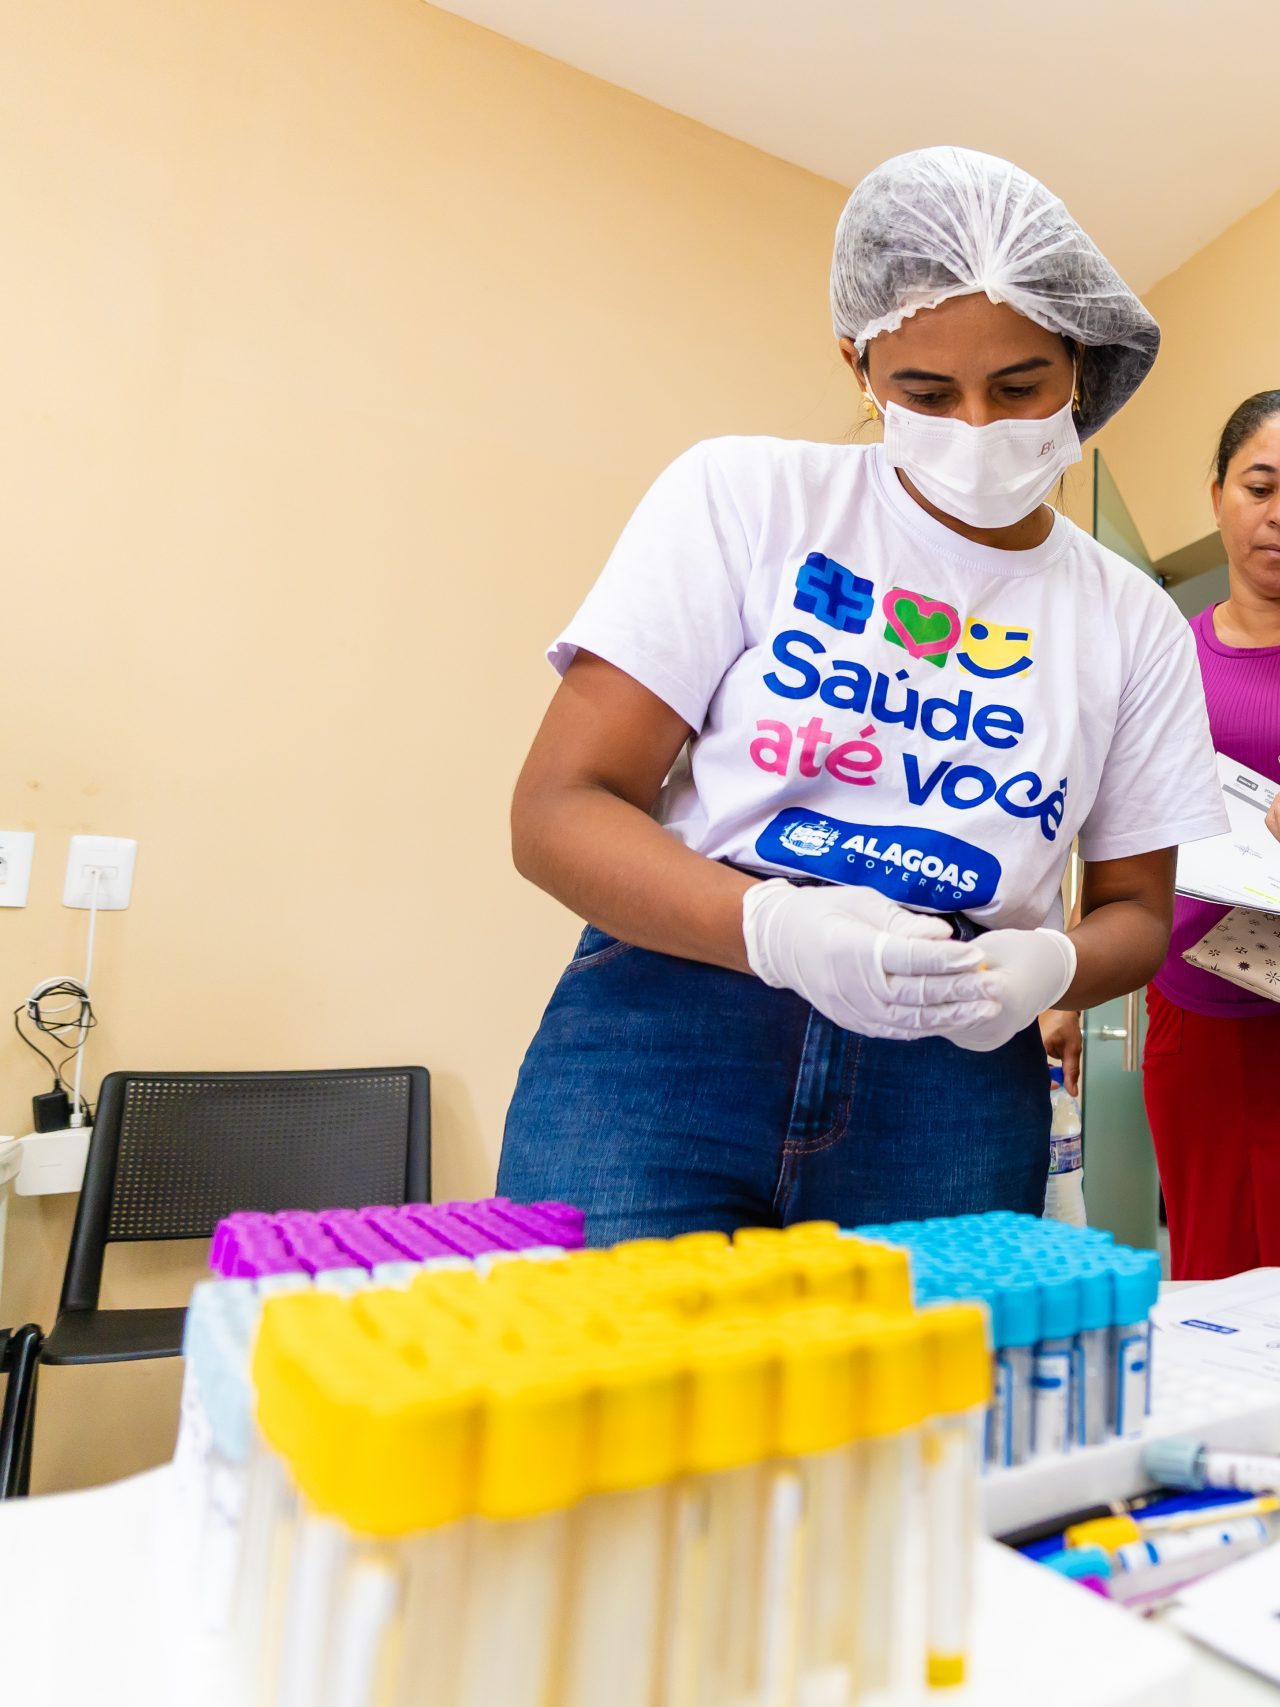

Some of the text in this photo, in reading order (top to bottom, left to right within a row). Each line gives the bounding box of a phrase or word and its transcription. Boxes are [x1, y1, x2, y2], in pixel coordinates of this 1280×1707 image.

[762, 629, 1025, 750] Saúde
[749, 716, 1068, 842] até você
[841, 834, 980, 893] ALAGOAS
[846, 854, 963, 900] GOVERNO
